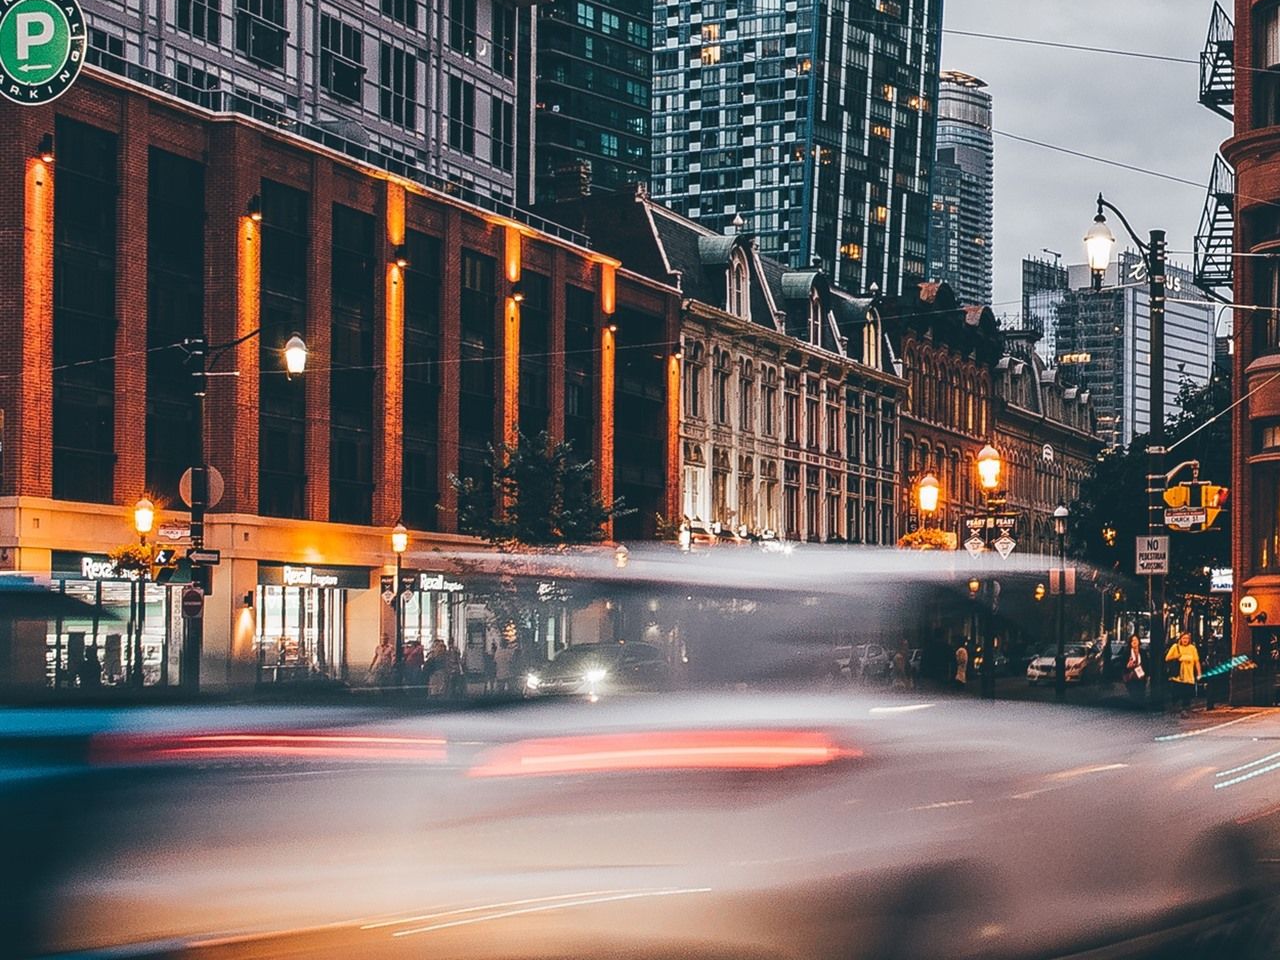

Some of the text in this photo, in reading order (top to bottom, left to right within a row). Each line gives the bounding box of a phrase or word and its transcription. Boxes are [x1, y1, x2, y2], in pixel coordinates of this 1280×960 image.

[16, 11, 55, 60] P
[1147, 539, 1159, 551] NO
[1138, 552, 1167, 561] PEDESTRIAN
[82, 557, 118, 580] Rexa
[283, 566, 312, 586] Rexall
